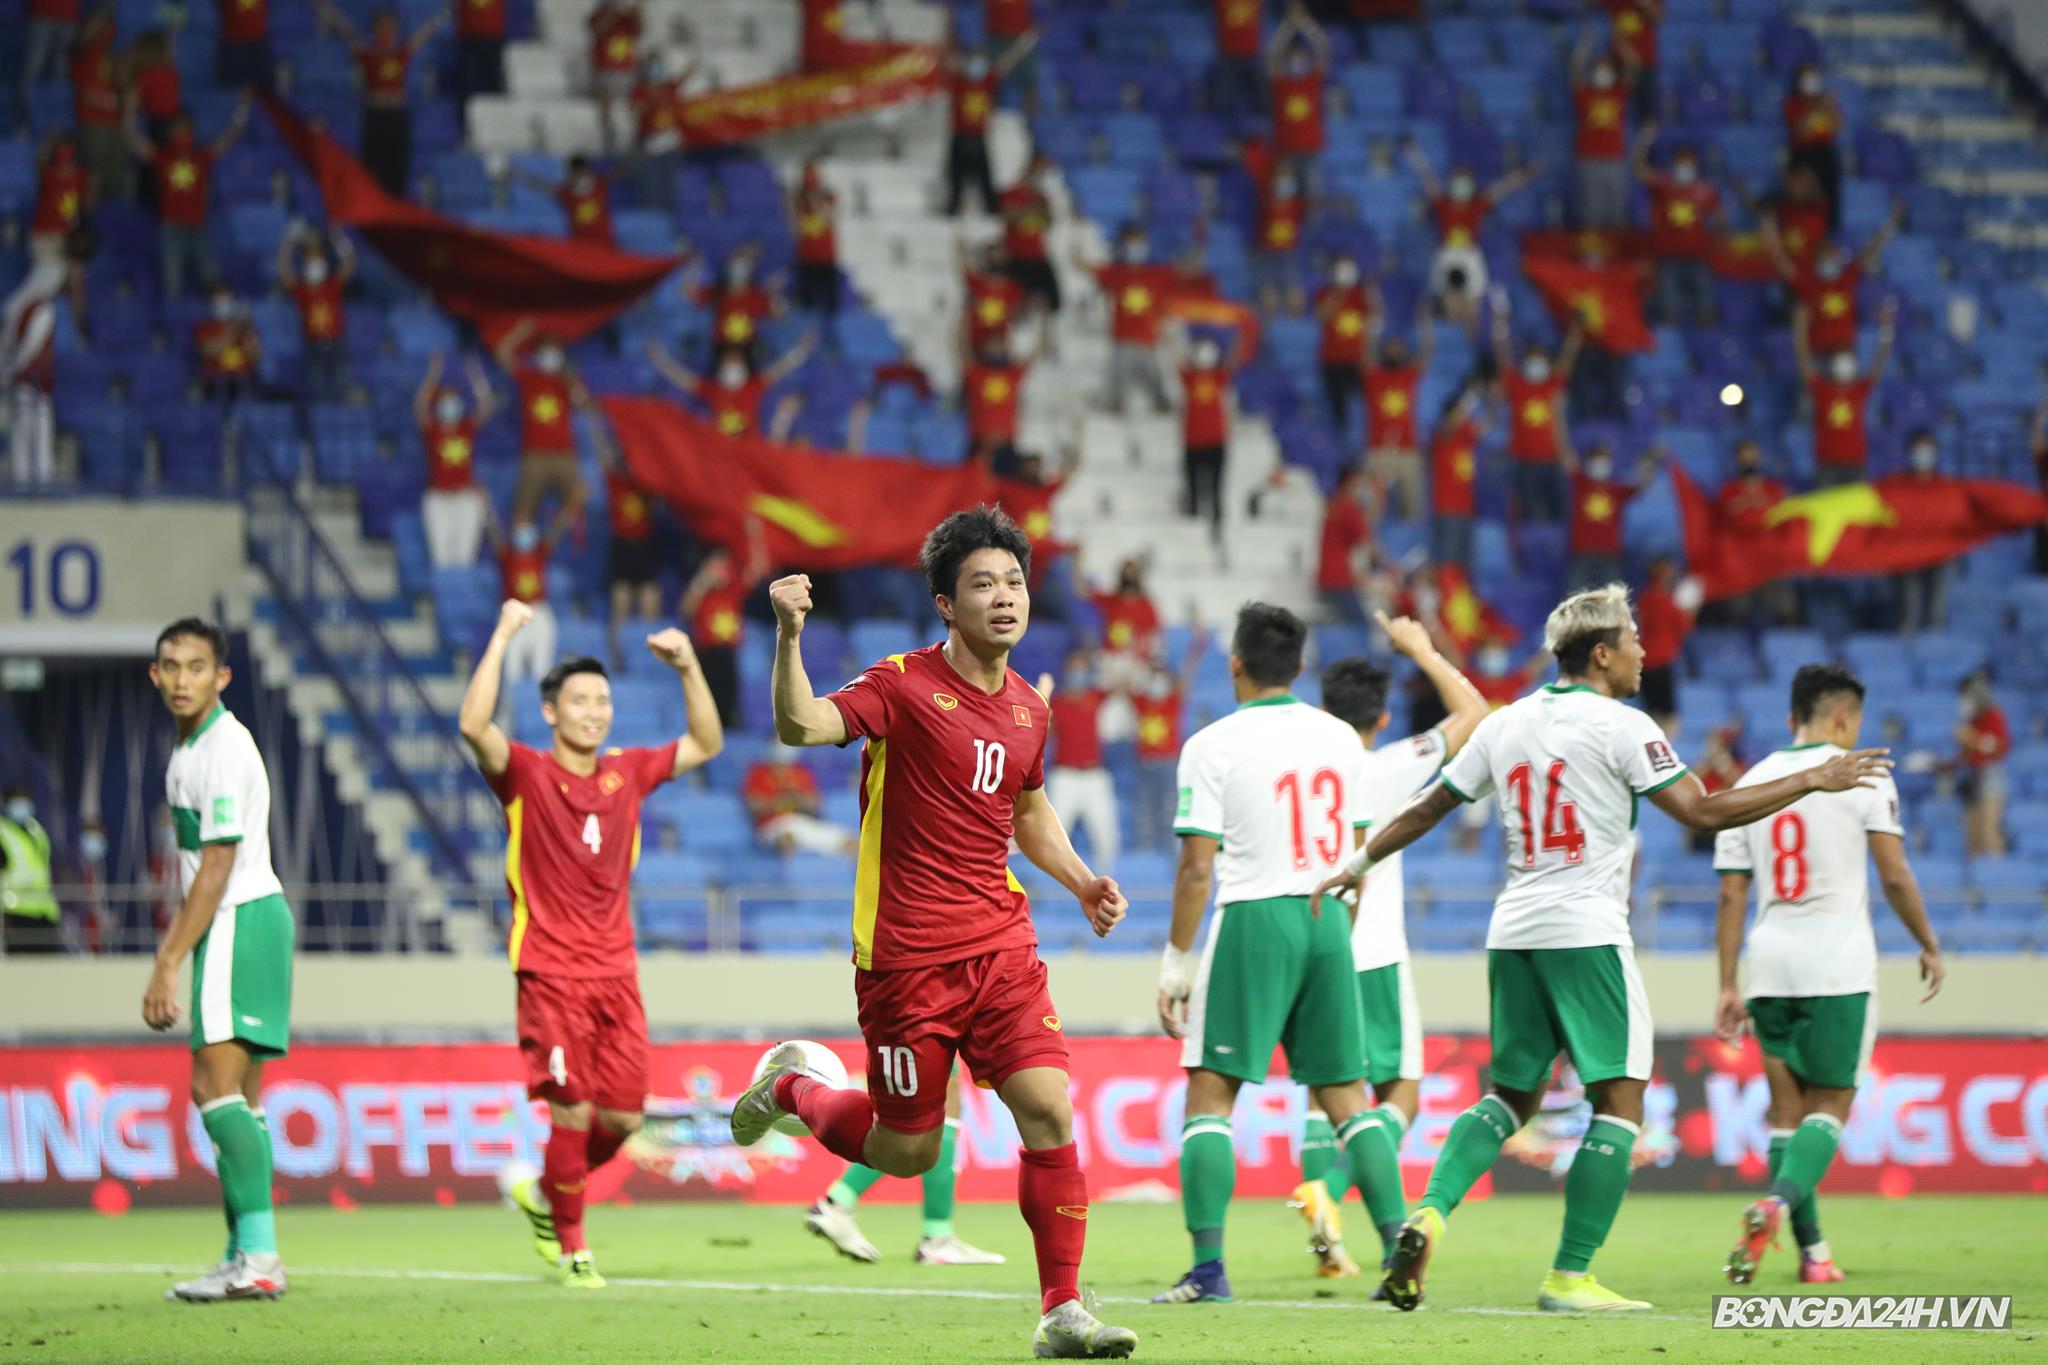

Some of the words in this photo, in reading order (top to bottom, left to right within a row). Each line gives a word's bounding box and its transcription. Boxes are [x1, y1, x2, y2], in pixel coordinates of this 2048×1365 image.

[8, 538, 101, 620] 10
[972, 738, 1006, 794] 10
[582, 812, 603, 855] 4
[1273, 767, 1344, 872] 13
[1506, 758, 1586, 868] 14
[1771, 811, 1809, 902] 8
[548, 1044, 568, 1087] 4
[878, 1046, 918, 1097] 10
